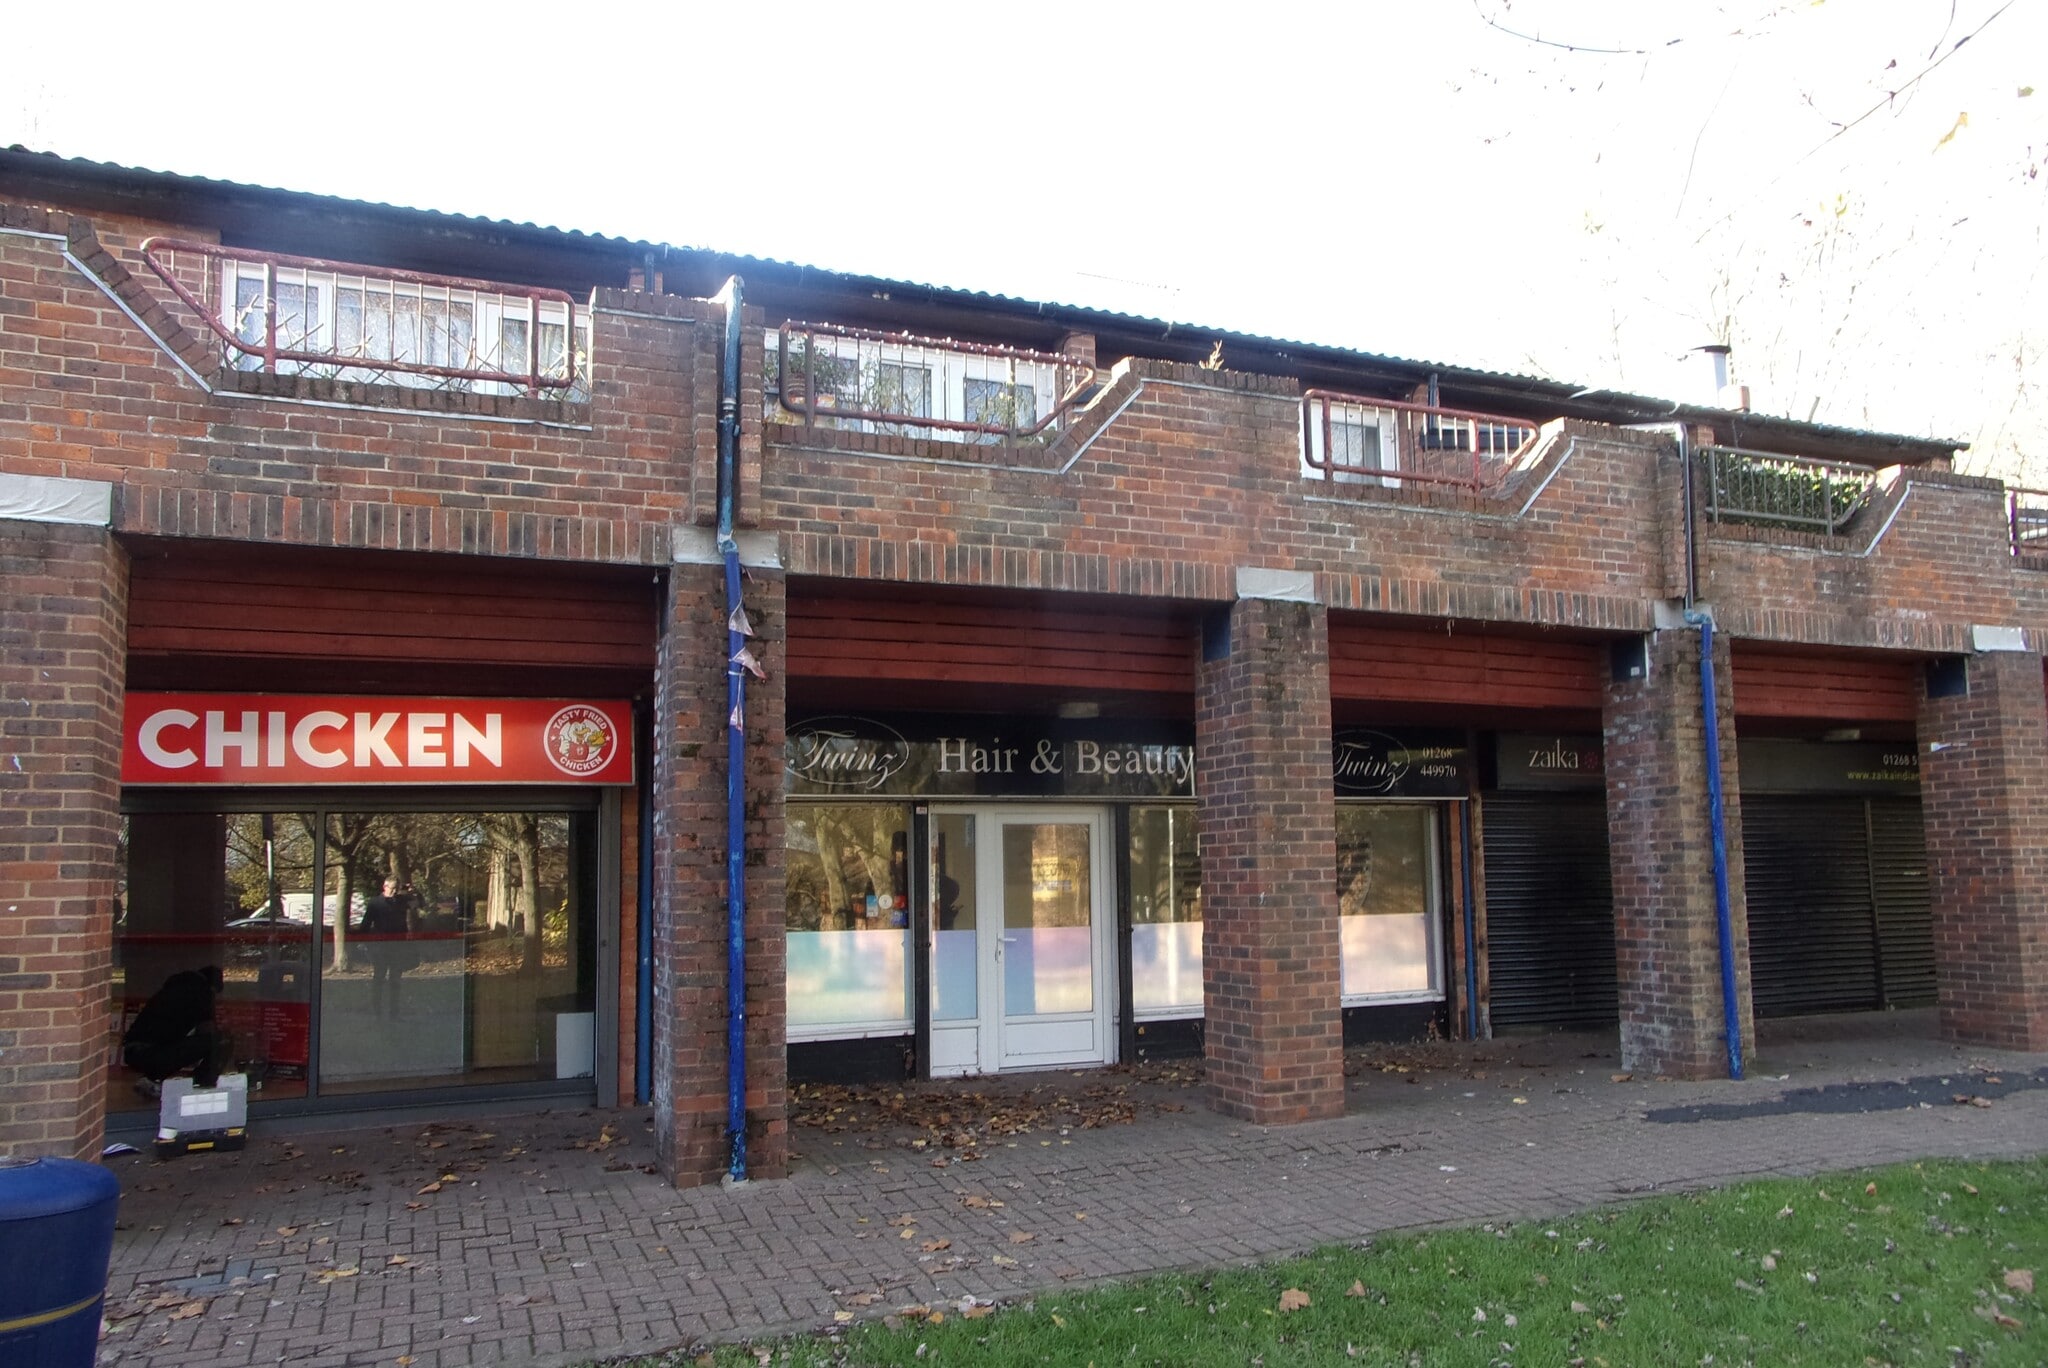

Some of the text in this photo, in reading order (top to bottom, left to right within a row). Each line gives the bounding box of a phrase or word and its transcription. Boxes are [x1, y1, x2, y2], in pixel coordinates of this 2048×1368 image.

[553, 709, 608, 730] TASTY FRIED
[138, 708, 502, 768] CHICKEN
[560, 755, 603, 770] CHICKEN
[789, 727, 898, 790] Twinz
[936, 737, 1195, 784] Hair & Beauty
[1422, 747, 1453, 758] 01268
[1528, 738, 1579, 769] zaika
[1883, 754, 1909, 765] 01268
[1333, 741, 1402, 793] Twinz
[1420, 765, 1456, 776] 449970
